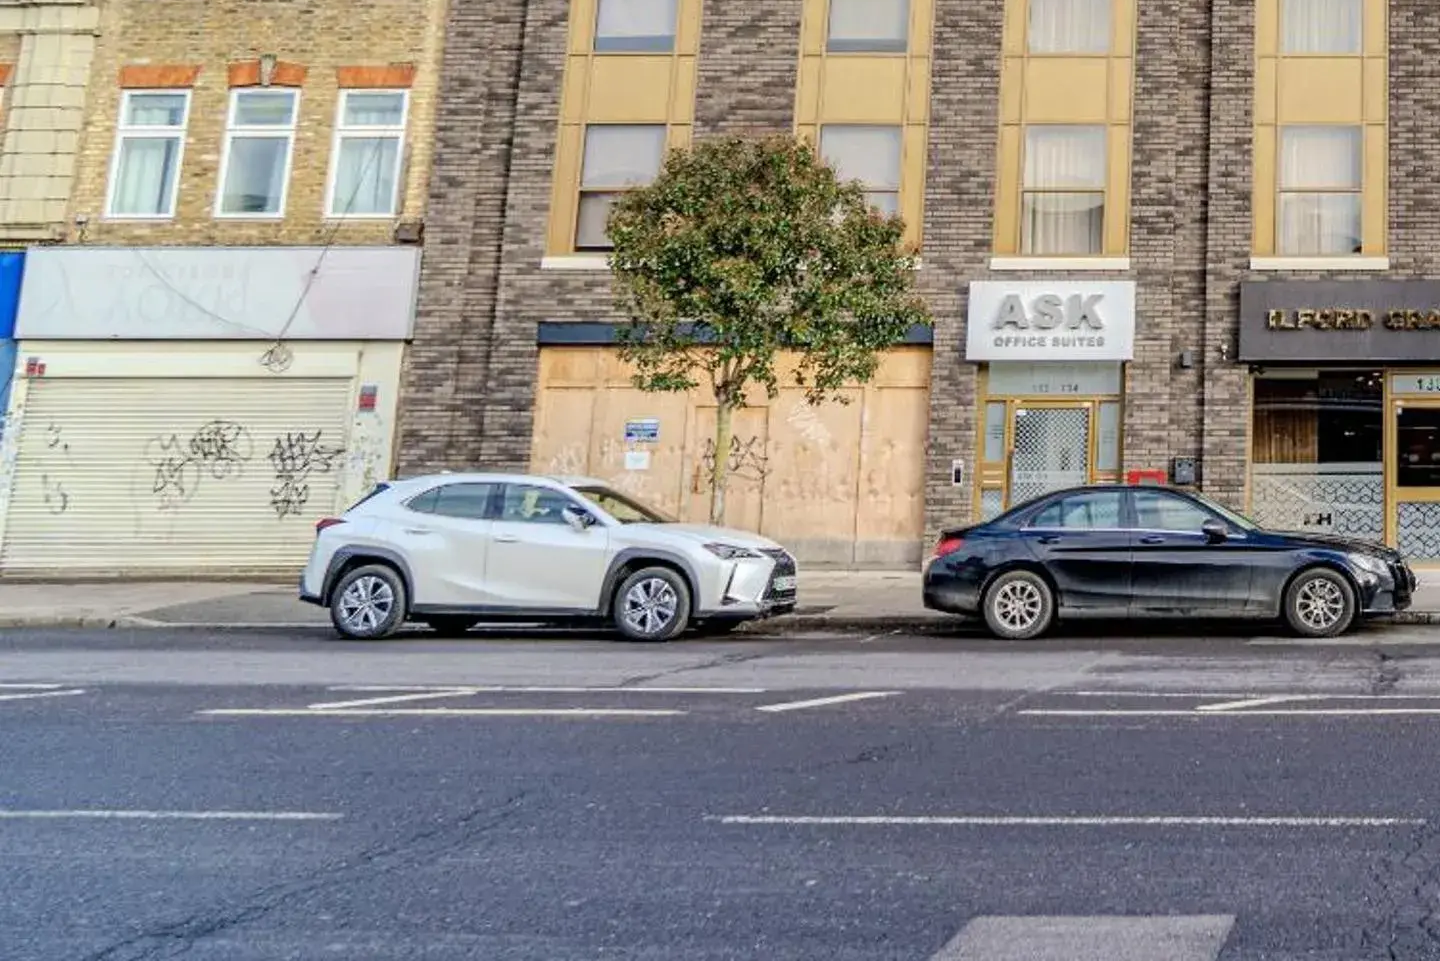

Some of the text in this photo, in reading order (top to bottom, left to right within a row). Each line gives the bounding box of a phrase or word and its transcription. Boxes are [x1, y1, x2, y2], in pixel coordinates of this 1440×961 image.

[992, 294, 1105, 330] ASK
[1266, 309, 1373, 330] ILFORD
[993, 337, 1105, 347] OFFICE SUITES
